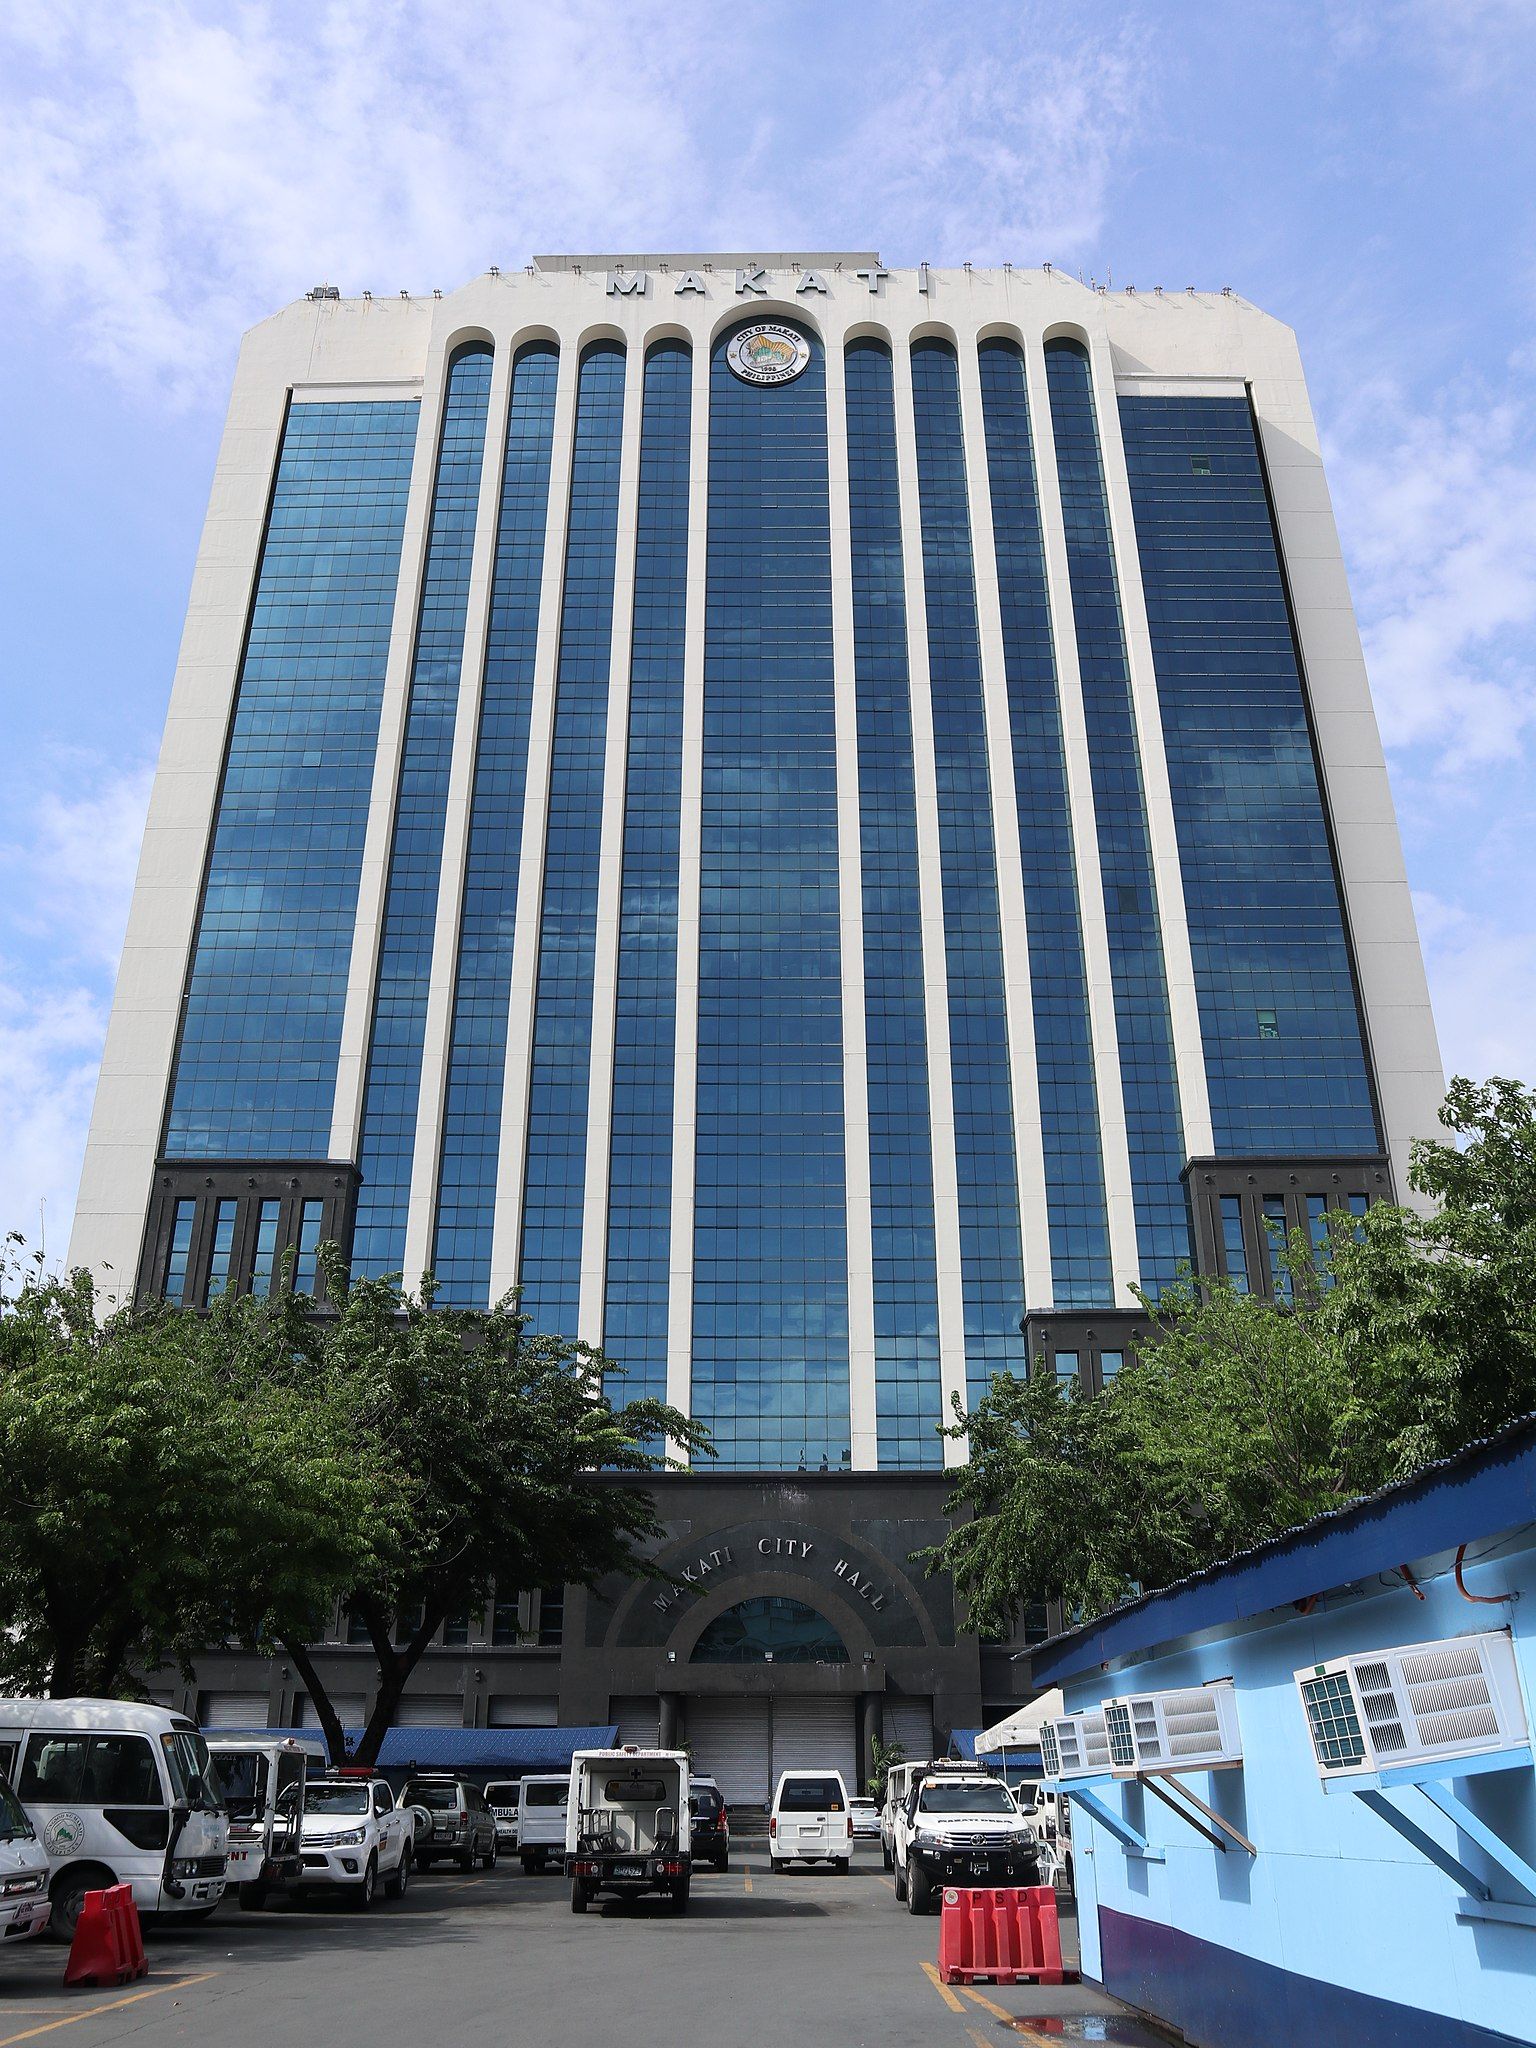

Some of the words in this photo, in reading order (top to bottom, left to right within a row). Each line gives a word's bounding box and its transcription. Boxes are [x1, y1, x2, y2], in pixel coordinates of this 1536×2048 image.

[606, 269, 929, 295] MAKATI
[736, 328, 754, 342] CITY
[754, 325, 767, 333] OF
[768, 325, 801, 342] MAKATI
[740, 367, 796, 381] PHILIPPINES
[652, 1546, 733, 1613] MAKATI
[758, 1537, 813, 1558] CITY
[832, 1558, 884, 1612] HALL
[492, 1808, 518, 1816] MBULA
